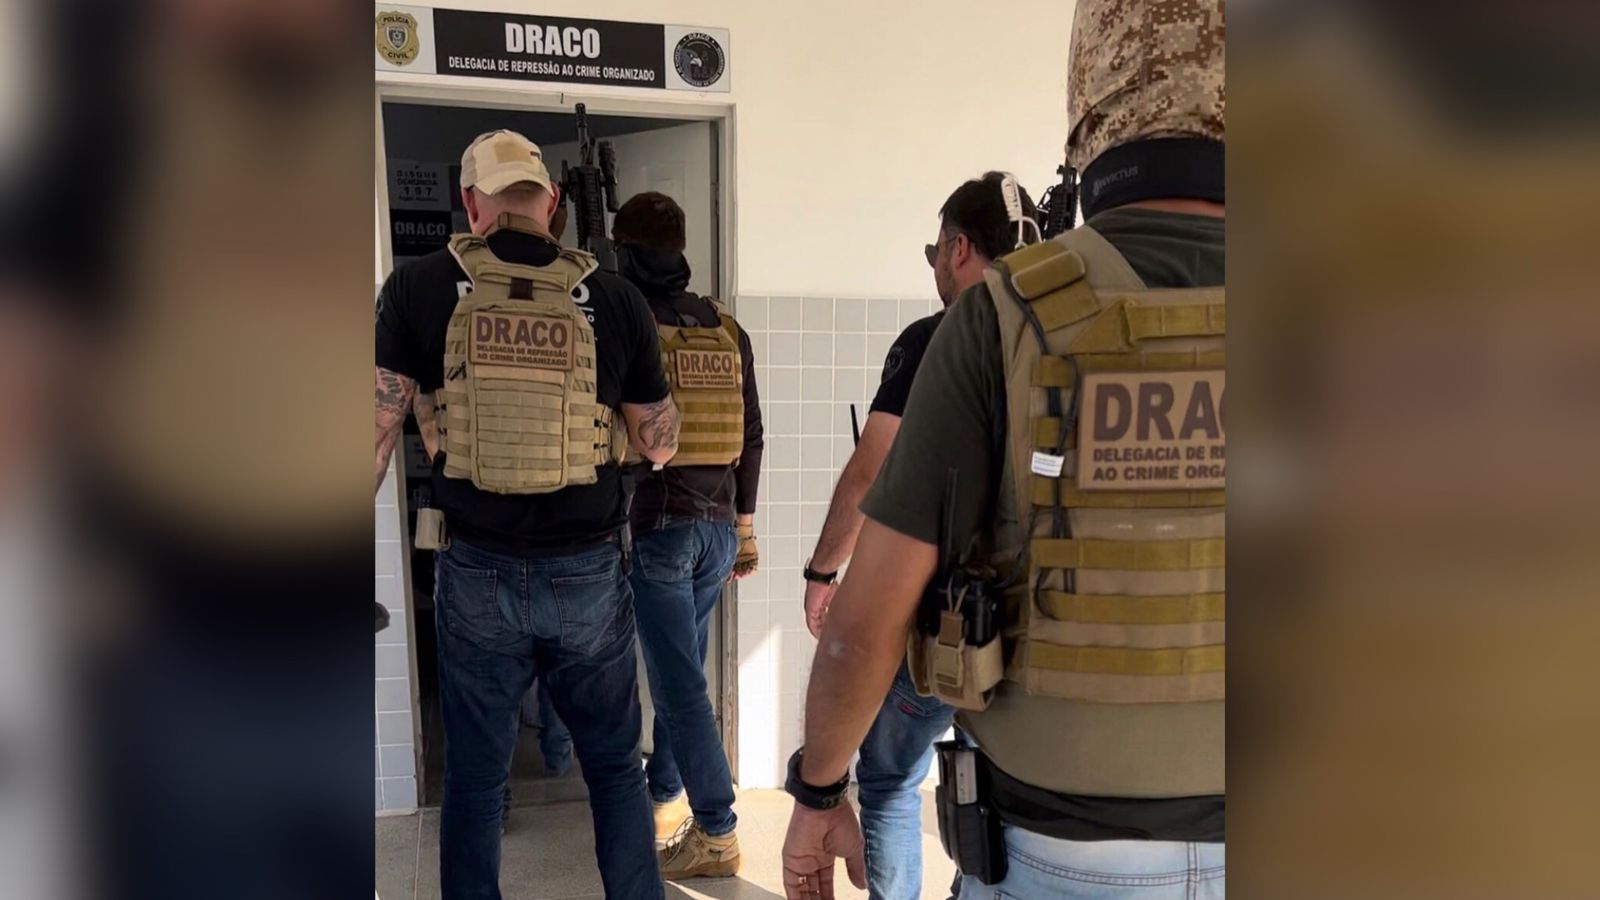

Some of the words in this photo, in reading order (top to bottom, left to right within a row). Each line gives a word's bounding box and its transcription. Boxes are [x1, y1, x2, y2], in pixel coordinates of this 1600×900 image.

[505, 22, 601, 59] DRACO
[448, 56, 496, 71] DELEGACIA
[498, 60, 510, 72] DE
[511, 60, 560, 75] REPRESSÃO
[562, 64, 574, 76] AO
[575, 65, 601, 78] CRIME
[602, 67, 655, 81] ORGANIZADO
[395, 221, 446, 237] DRACO
[476, 316, 568, 349] DRACO
[680, 353, 733, 374] DRACO
[1093, 381, 1225, 441] DRA
[1093, 447, 1181, 462] DELEGACIA
[1186, 446, 1206, 460] DE
[1093, 467, 1117, 481] AO
[1123, 466, 1179, 480] CRIME
